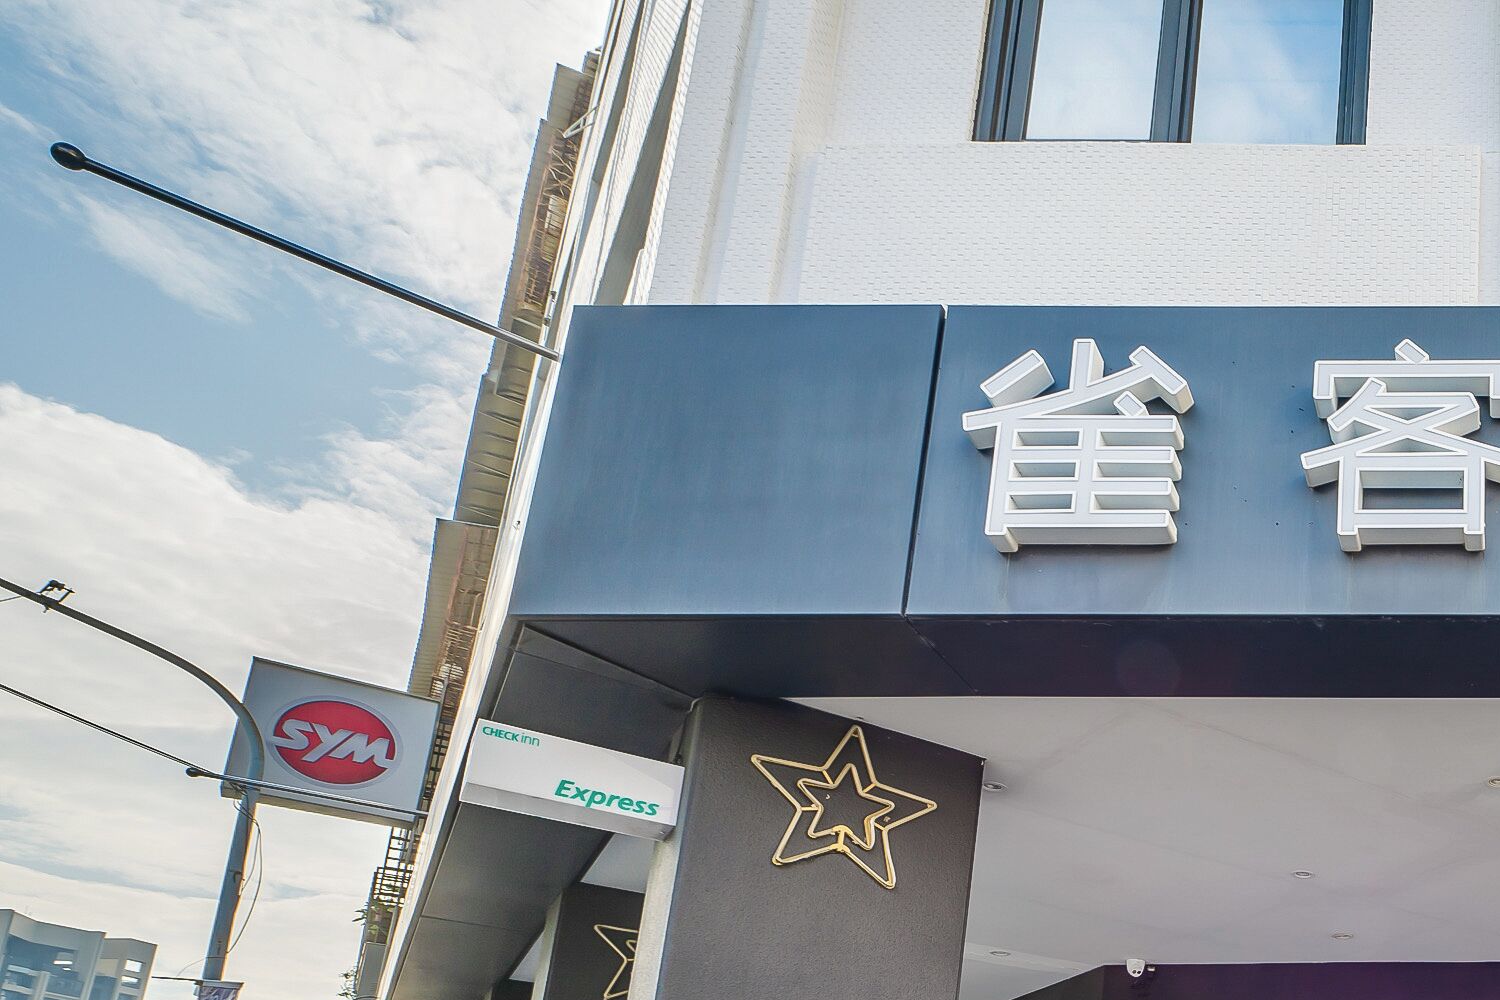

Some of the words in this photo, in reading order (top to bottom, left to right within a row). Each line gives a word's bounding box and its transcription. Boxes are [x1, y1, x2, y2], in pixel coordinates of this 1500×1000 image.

[272, 718, 396, 769] SYM
[482, 726, 519, 742] CHECK
[521, 732, 540, 747] inn
[554, 779, 660, 817] Express
